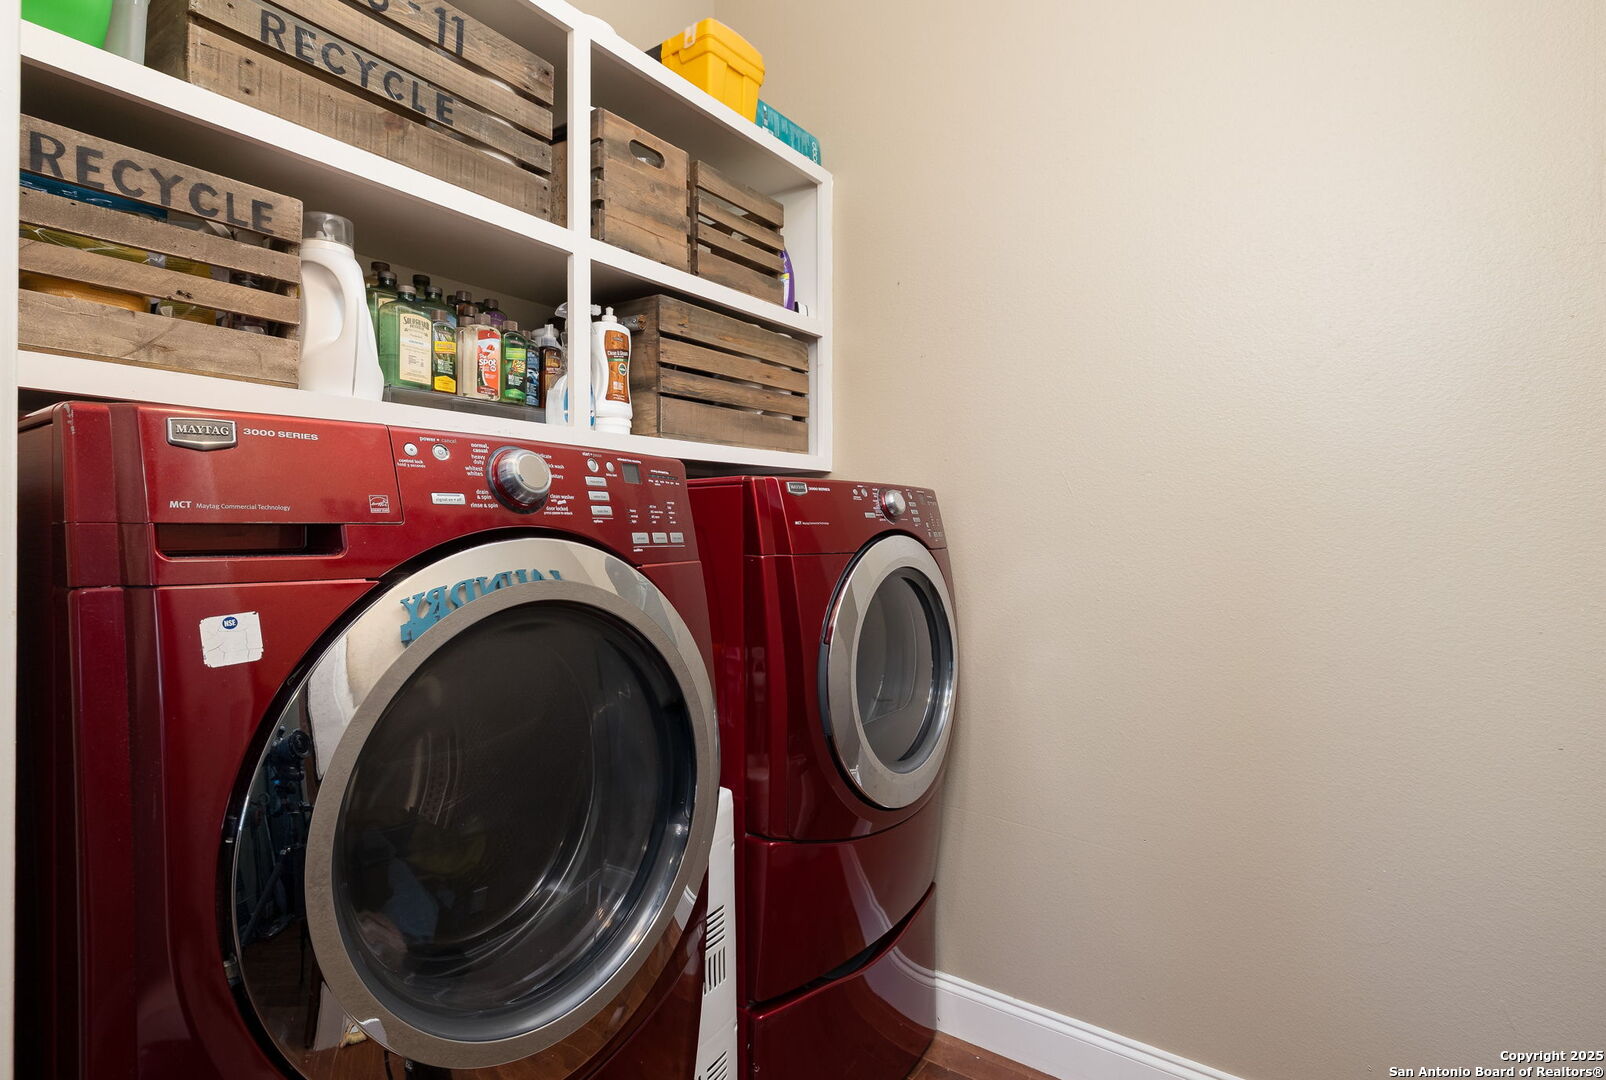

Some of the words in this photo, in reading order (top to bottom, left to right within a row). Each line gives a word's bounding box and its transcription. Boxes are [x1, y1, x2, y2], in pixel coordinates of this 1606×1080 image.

[259, 9, 455, 125] RECYCLE
[29, 130, 274, 235] RECYCLE
[175, 424, 229, 436] MAYTAG
[243, 428, 275, 437] 3000
[278, 431, 319, 441] SERIES
[169, 501, 192, 509] MCT
[196, 503, 220, 511] Maytag
[221, 503, 257, 511] Commercial
[258, 503, 291, 512] Technology
